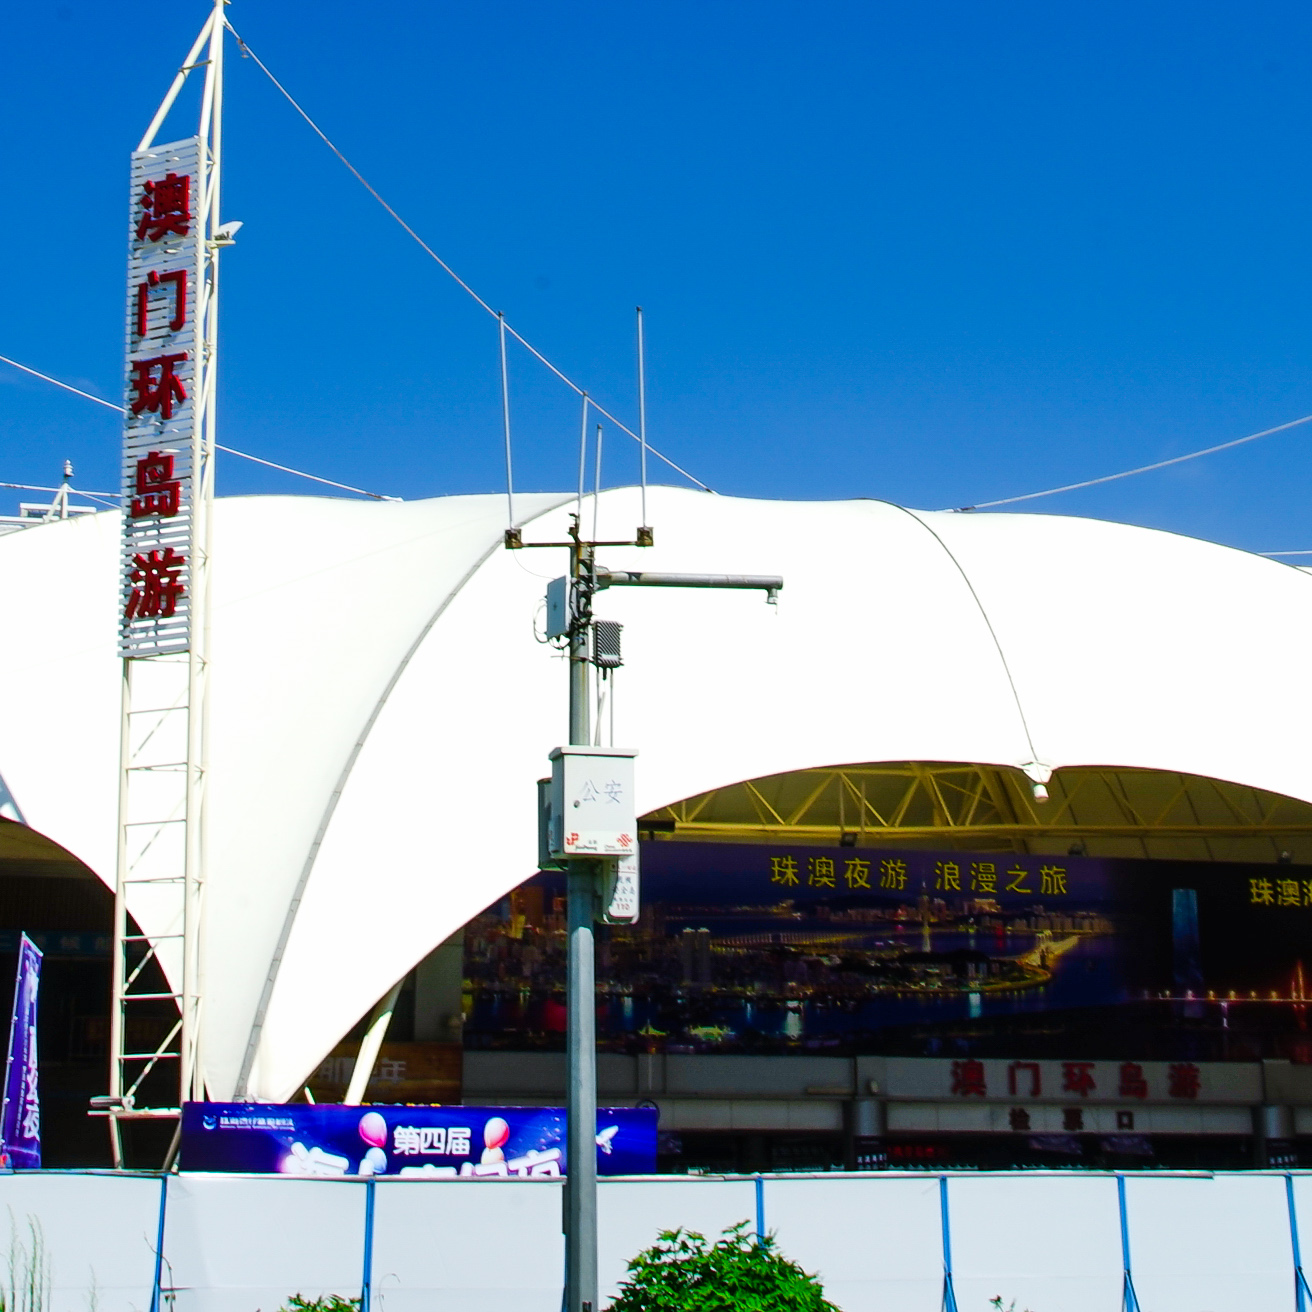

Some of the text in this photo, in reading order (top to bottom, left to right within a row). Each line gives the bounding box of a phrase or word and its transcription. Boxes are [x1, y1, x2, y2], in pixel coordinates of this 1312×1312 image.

[126, 172, 191, 619] 澳门环岛游
[581, 779, 623, 804] 公安
[771, 856, 1067, 895] 珠澳夜游 浪漫之旅
[951, 1059, 1201, 1099] 澳门环岛游
[393, 1125, 471, 1155] 第四届
